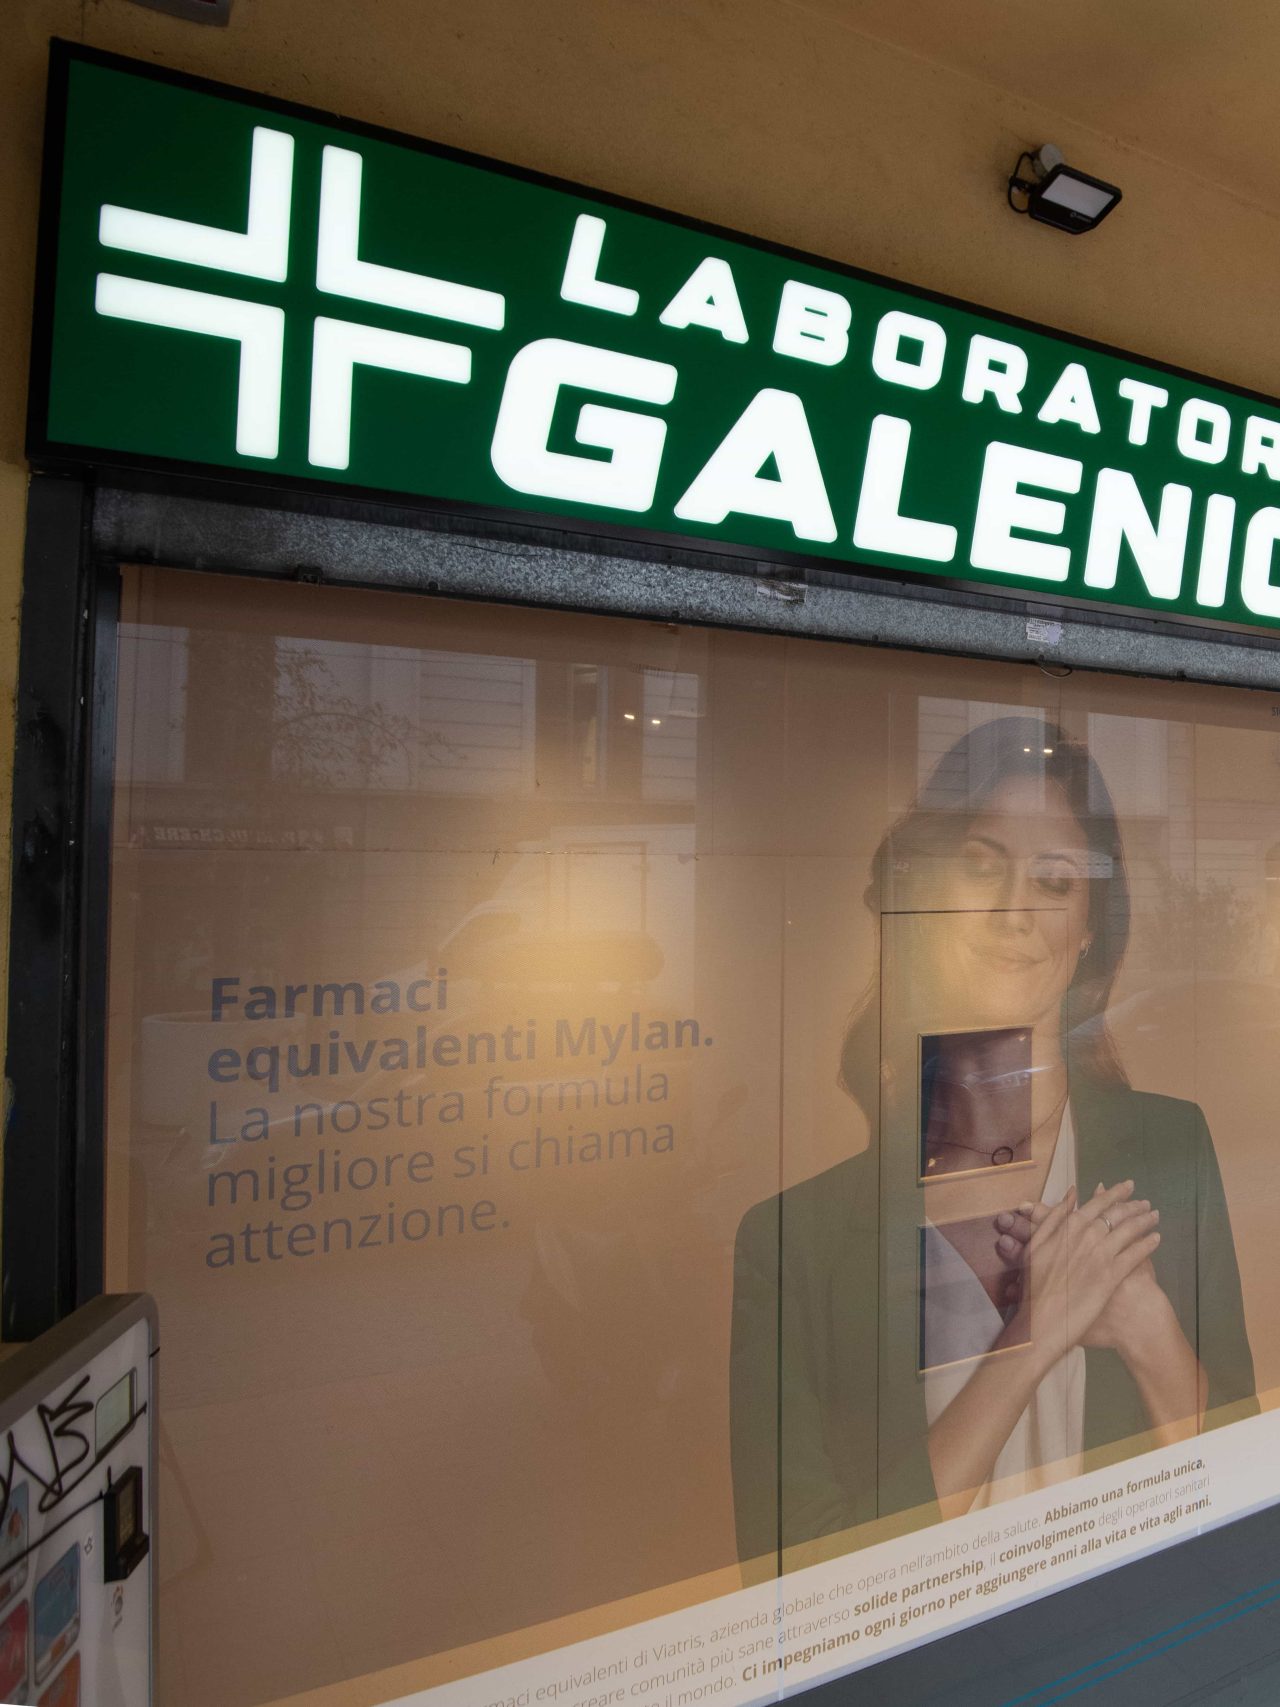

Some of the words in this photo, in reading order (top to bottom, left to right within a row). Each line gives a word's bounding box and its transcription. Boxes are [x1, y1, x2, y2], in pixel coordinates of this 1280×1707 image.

[211, 968, 447, 1022] Farmaci
[207, 1018, 536, 1093] equivalenti
[555, 1012, 713, 1067] Mylan.
[209, 1101, 270, 1145] La
[294, 1089, 464, 1137] nostra
[484, 1063, 669, 1120] formula
[208, 1149, 434, 1211] migliore
[453, 1133, 488, 1178] si
[508, 1122, 674, 1171] chiama
[205, 1200, 510, 1269] attenzione.
[484, 1687, 530, 1707] maci
[535, 1658, 629, 1700] equivalenti
[633, 1651, 648, 1669] di
[652, 1631, 705, 1662] Viatris,
[710, 1612, 768, 1643] azienda
[773, 1593, 825, 1625] globale
[829, 1584, 854, 1601] che
[857, 1568, 896, 1597] opera
[900, 1541, 969, 1578] nell'ambito
[972, 1529, 1001, 1550] della
[1003, 1518, 1041, 1539] salute.
[1044, 1496, 1099, 1524] Abbiamo
[1102, 1487, 1124, 1503] una
[1126, 1471, 1171, 1495] formula
[1174, 1458, 1205, 1477] unica,
[630, 1657, 706, 1696] comunità
[710, 1646, 734, 1672] più
[738, 1638, 773, 1660] sane
[777, 1610, 850, 1644] attraverso
[853, 1588, 898, 1616] solide
[901, 1557, 987, 1606] partnership,
[990, 1553, 996, 1567] il
[999, 1519, 1095, 1562] coinvolgimento
[1098, 1507, 1123, 1528] degli
[1125, 1490, 1172, 1521] operatori
[1174, 1475, 1210, 1499] sanitari
[678, 1675, 737, 1706] mondo.
[742, 1662, 757, 1682] Ci
[762, 1629, 860, 1676] impegniamo
[864, 1612, 896, 1639] ogni
[899, 1598, 945, 1627] giorno
[949, 1588, 972, 1609] per
[976, 1560, 1047, 1596] aggiungere
[1050, 1545, 1077, 1566] anni
[1080, 1537, 1102, 1555] alla
[1105, 1526, 1127, 1545] vita
[1129, 1526, 1137, 1535] e
[1139, 1516, 1160, 1532] vita
[1163, 1504, 1183, 1525] agli
[1185, 1494, 1212, 1514] anni.
